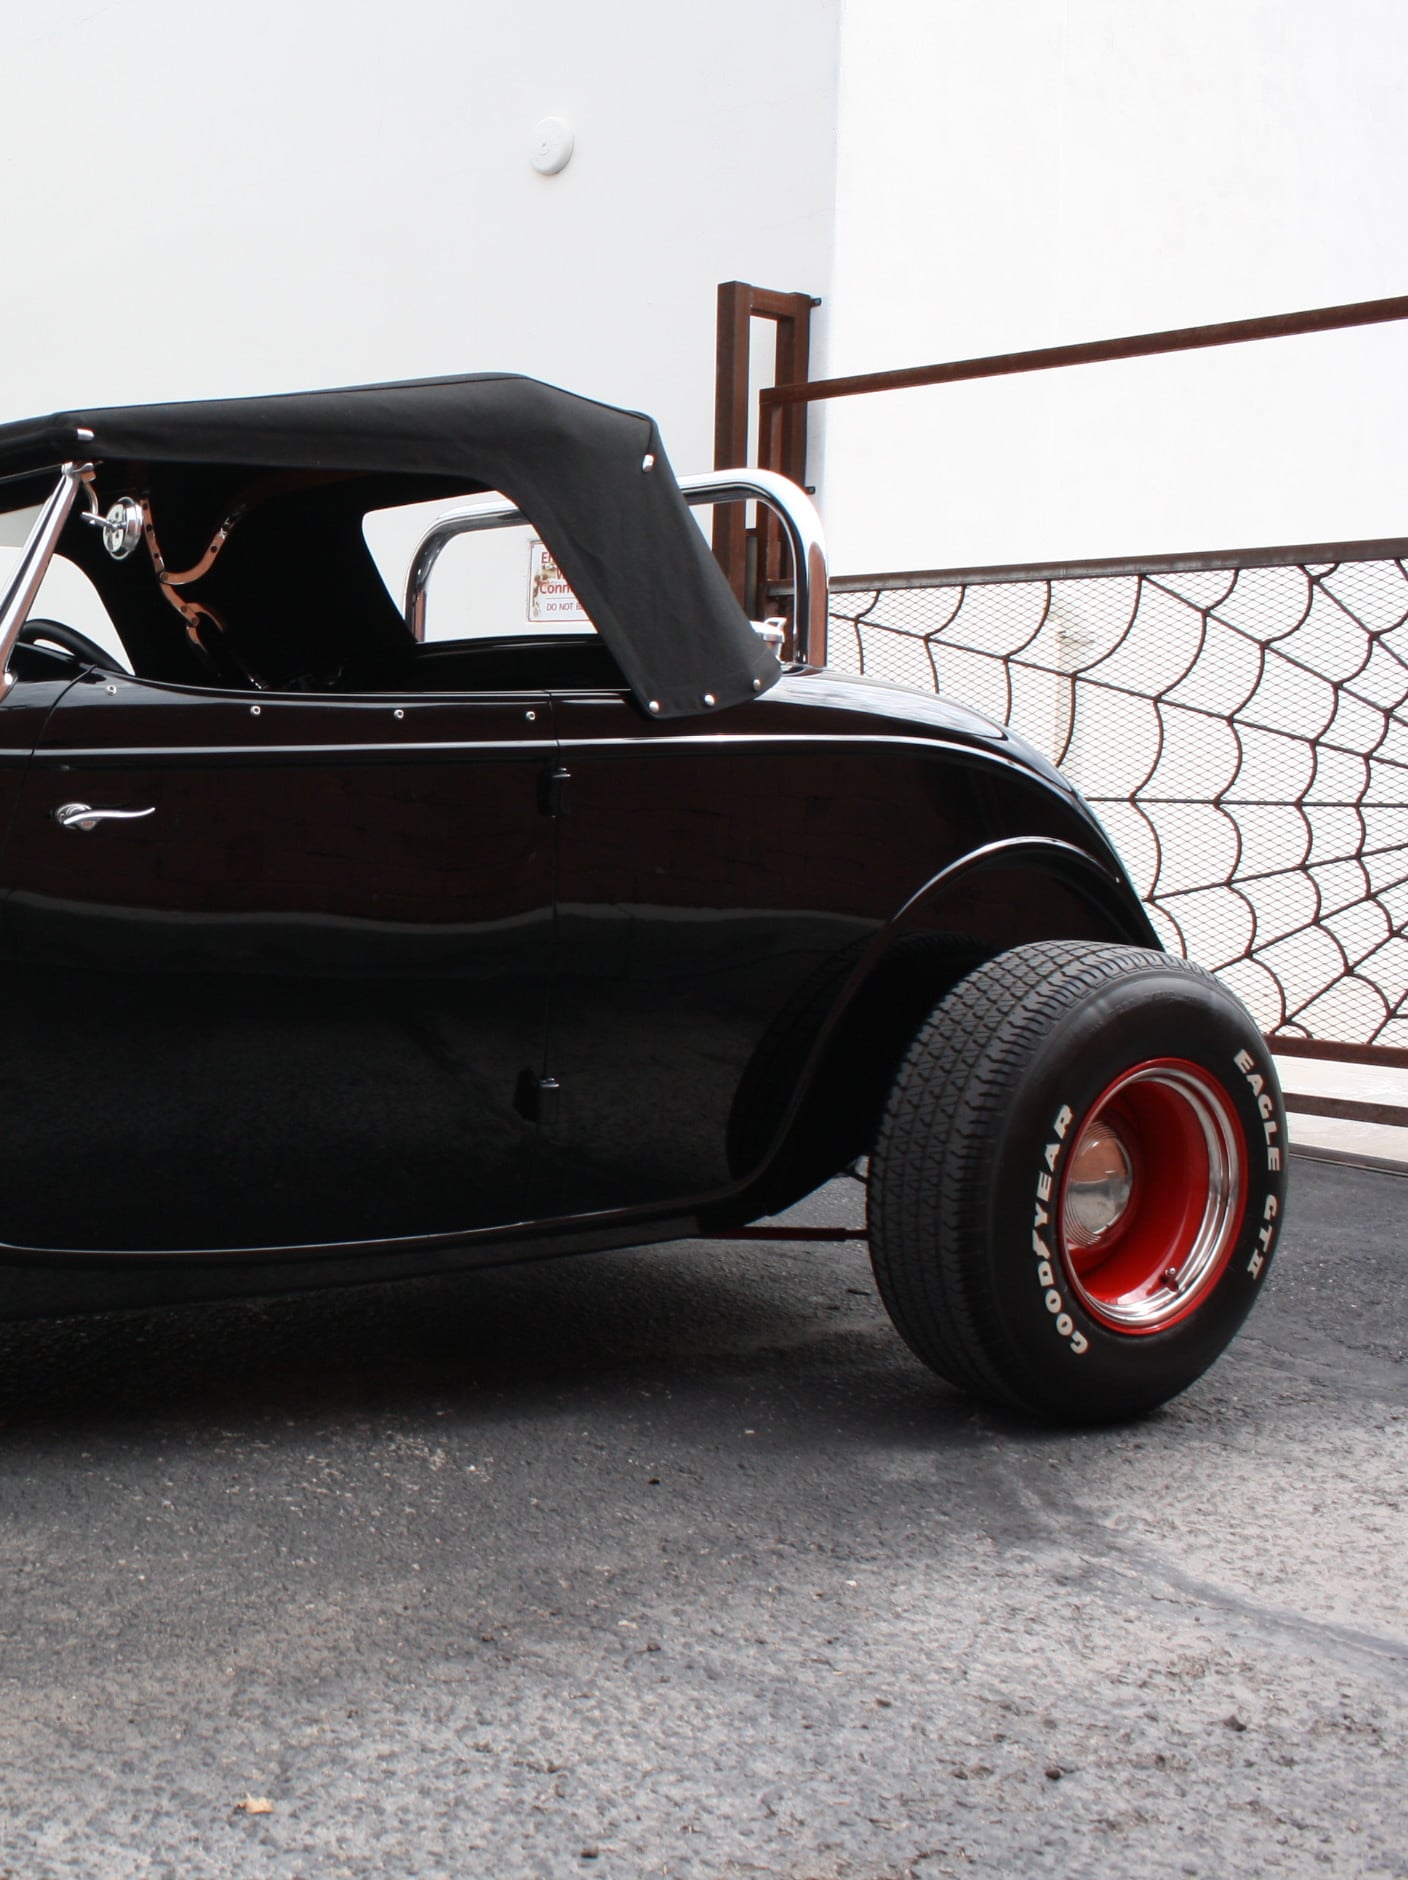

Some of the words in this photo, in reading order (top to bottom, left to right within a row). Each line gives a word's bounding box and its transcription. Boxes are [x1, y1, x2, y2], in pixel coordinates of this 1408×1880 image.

[540, 582, 570, 594] Conn
[546, 603, 557, 611] DO
[559, 602, 573, 611] NOT
[1233, 1048, 1281, 1172] EAGLE
[1032, 1103, 1089, 1355] GOODYEAR
